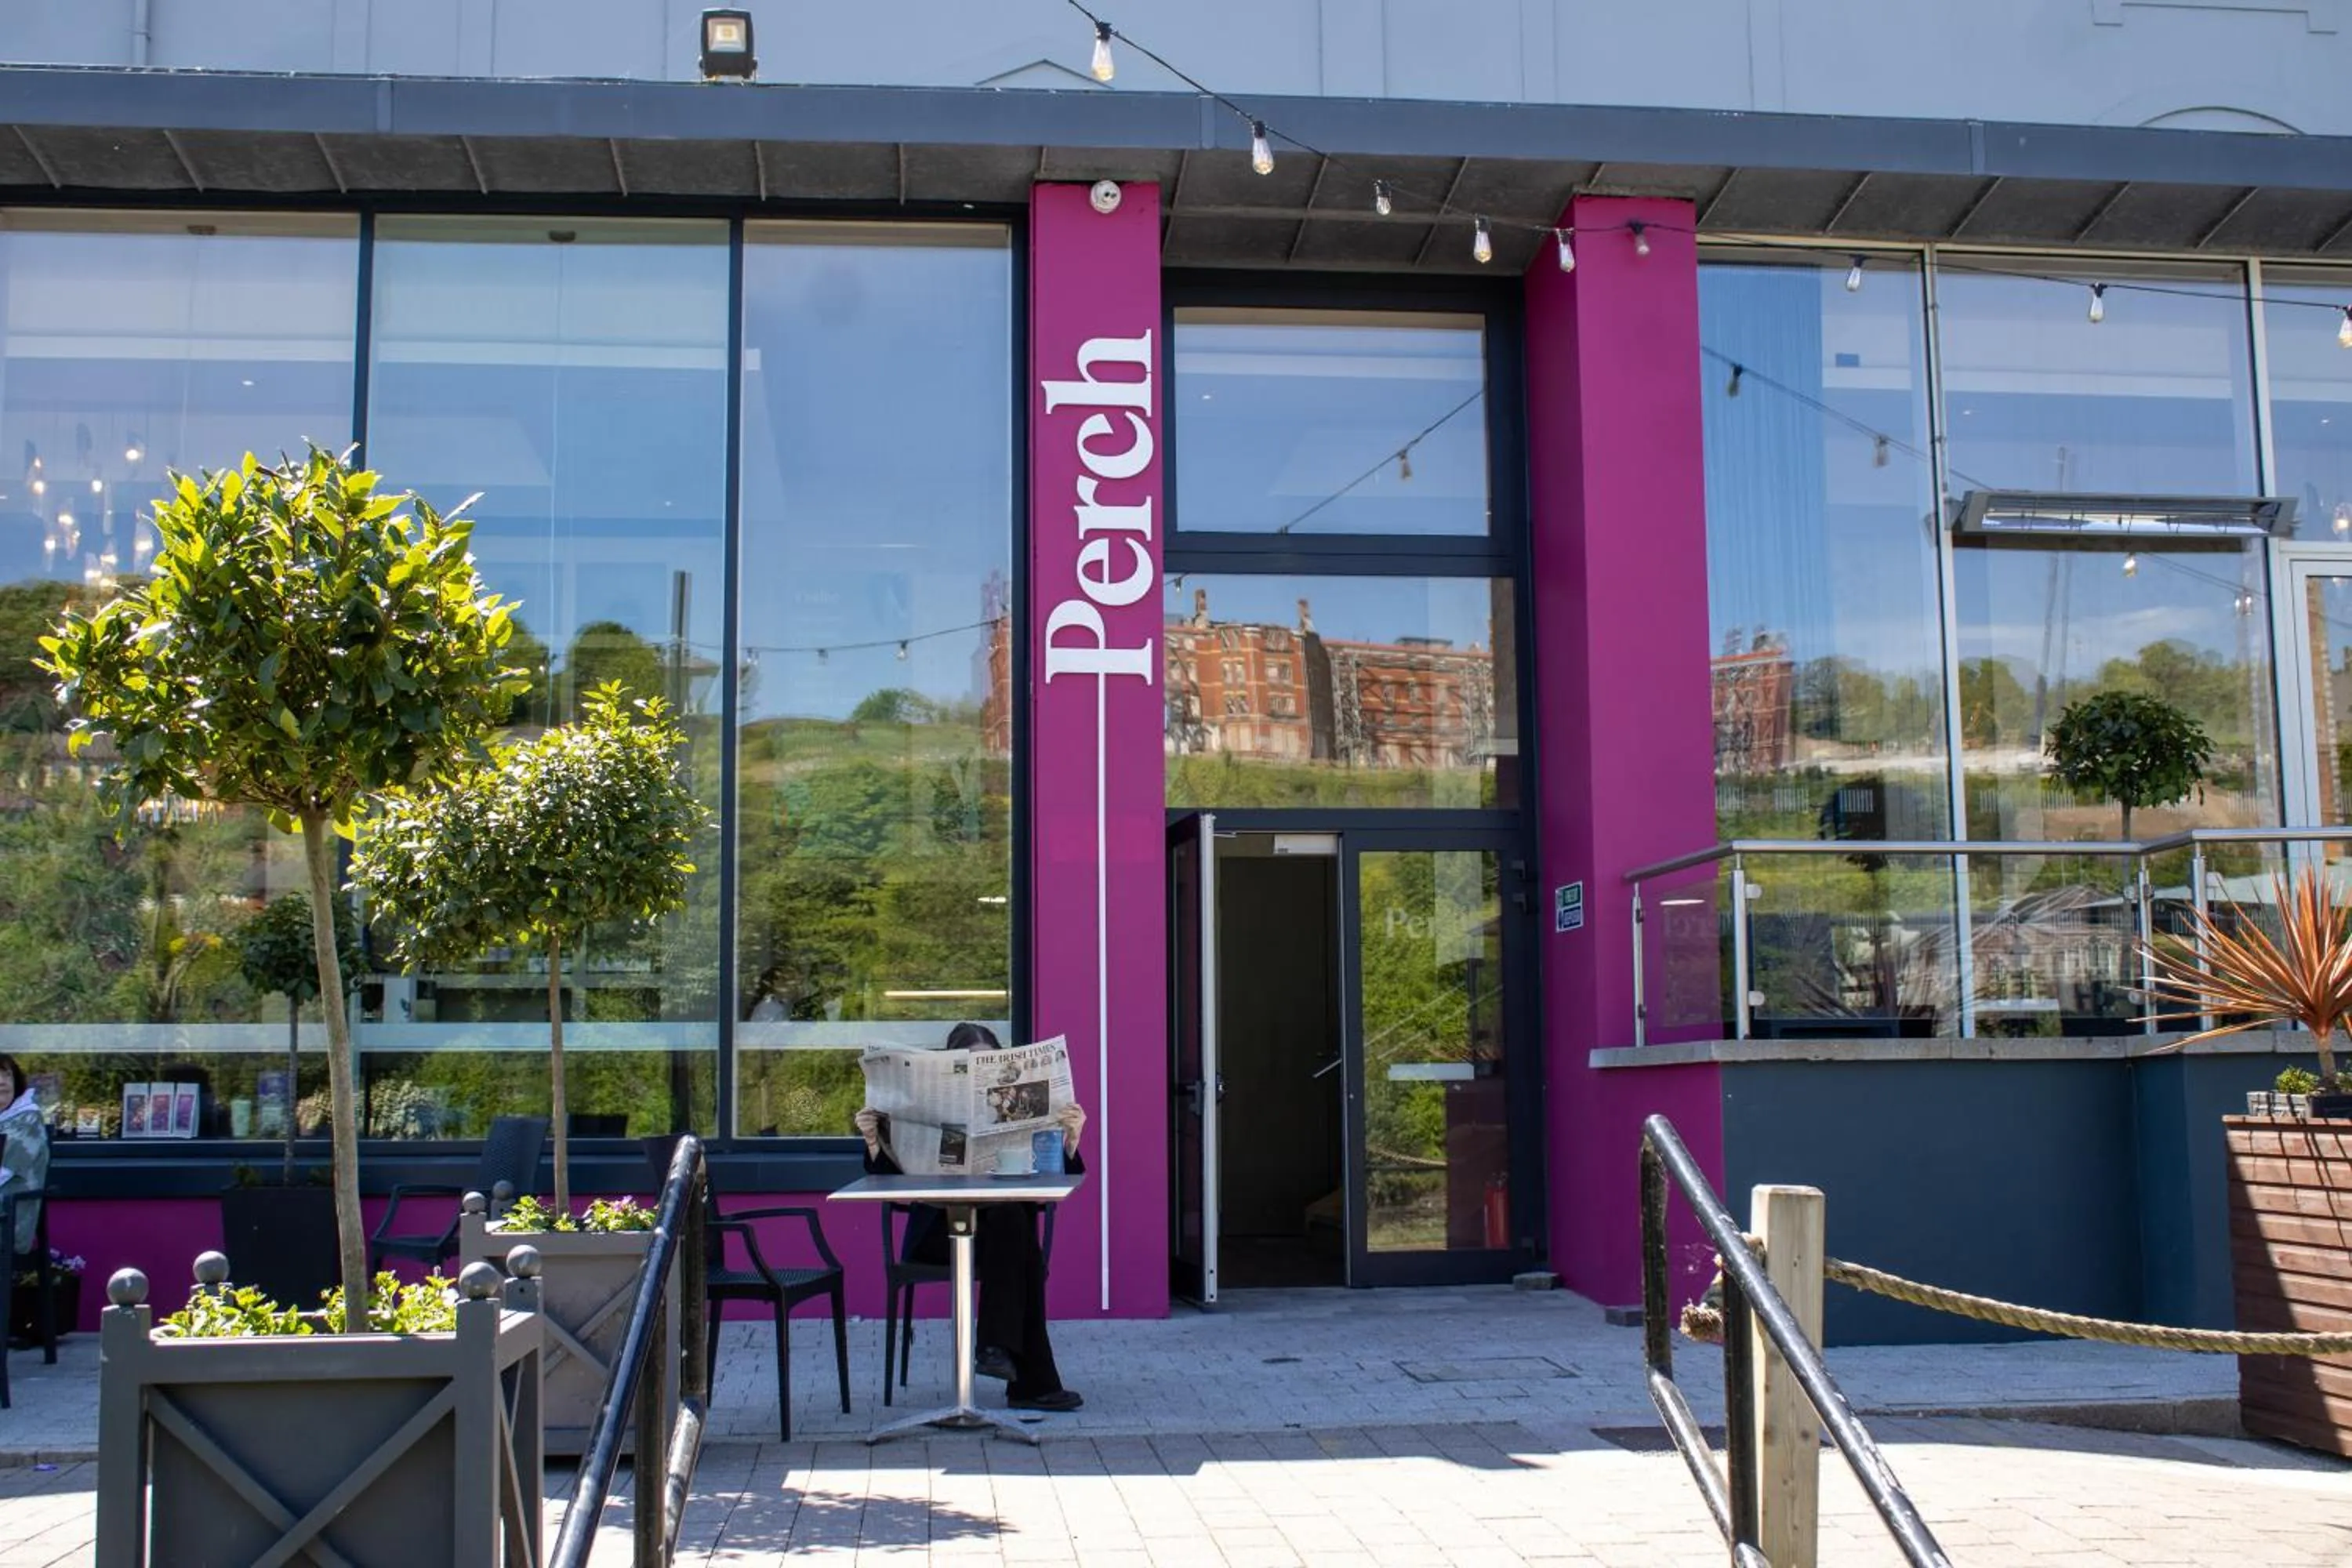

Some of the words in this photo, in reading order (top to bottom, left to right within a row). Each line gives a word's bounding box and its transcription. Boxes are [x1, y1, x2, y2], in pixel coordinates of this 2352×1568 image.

[1041, 328, 1154, 685] Perch
[1385, 906, 1472, 938] Per
[975, 1055, 997, 1065] THE
[999, 1050, 1027, 1063] IRISH
[1028, 1044, 1057, 1058] TIMES
